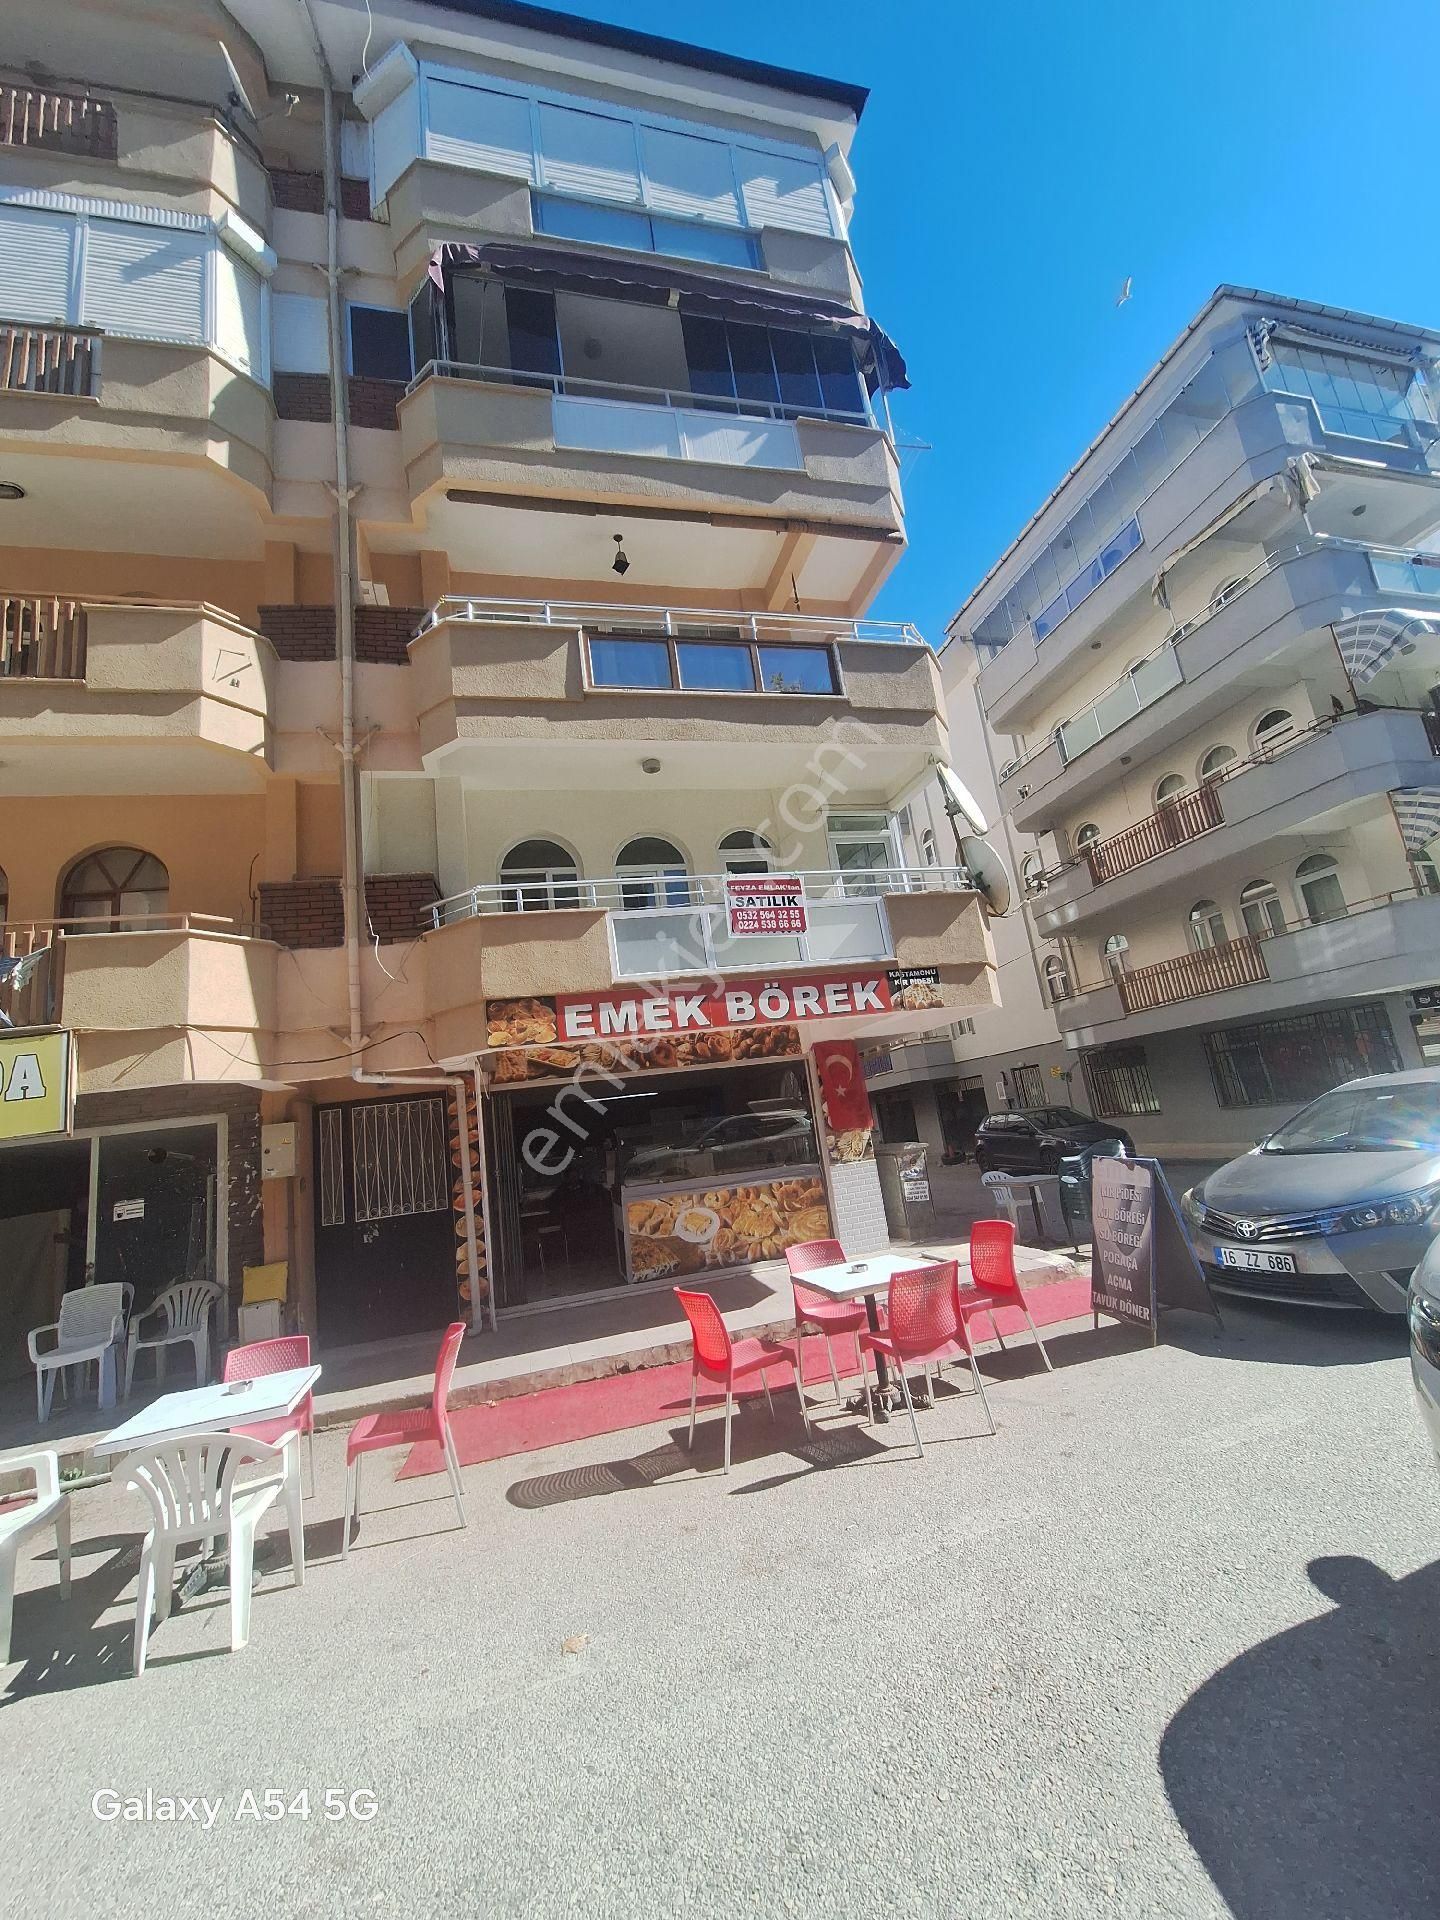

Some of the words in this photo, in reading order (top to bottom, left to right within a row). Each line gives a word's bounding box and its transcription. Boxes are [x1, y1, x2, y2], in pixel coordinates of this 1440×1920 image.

[735, 895, 798, 907] SATILIK
[737, 910, 757, 920] 0532
[760, 910, 775, 920] 564
[777, 910, 788, 919] 32
[789, 909, 800, 919] 55
[738, 920, 759, 930] 0224
[761, 920, 776, 929] 538
[778, 920, 789, 928] 66
[790, 919, 801, 928] 66
[888, 969, 936, 978] KASTAMONU
[564, 995, 711, 1037] EMEK
[724, 980, 885, 1022] BÖREK
[1223, 1250, 1236, 1264] 16
[1245, 1252, 1260, 1267] ZZ
[1267, 1255, 1291, 1271] 686
[1107, 1273, 1133, 1292] AÇMA
[1092, 1291, 1118, 1310] TAVUK
[1119, 1299, 1150, 1321] DÖNER
